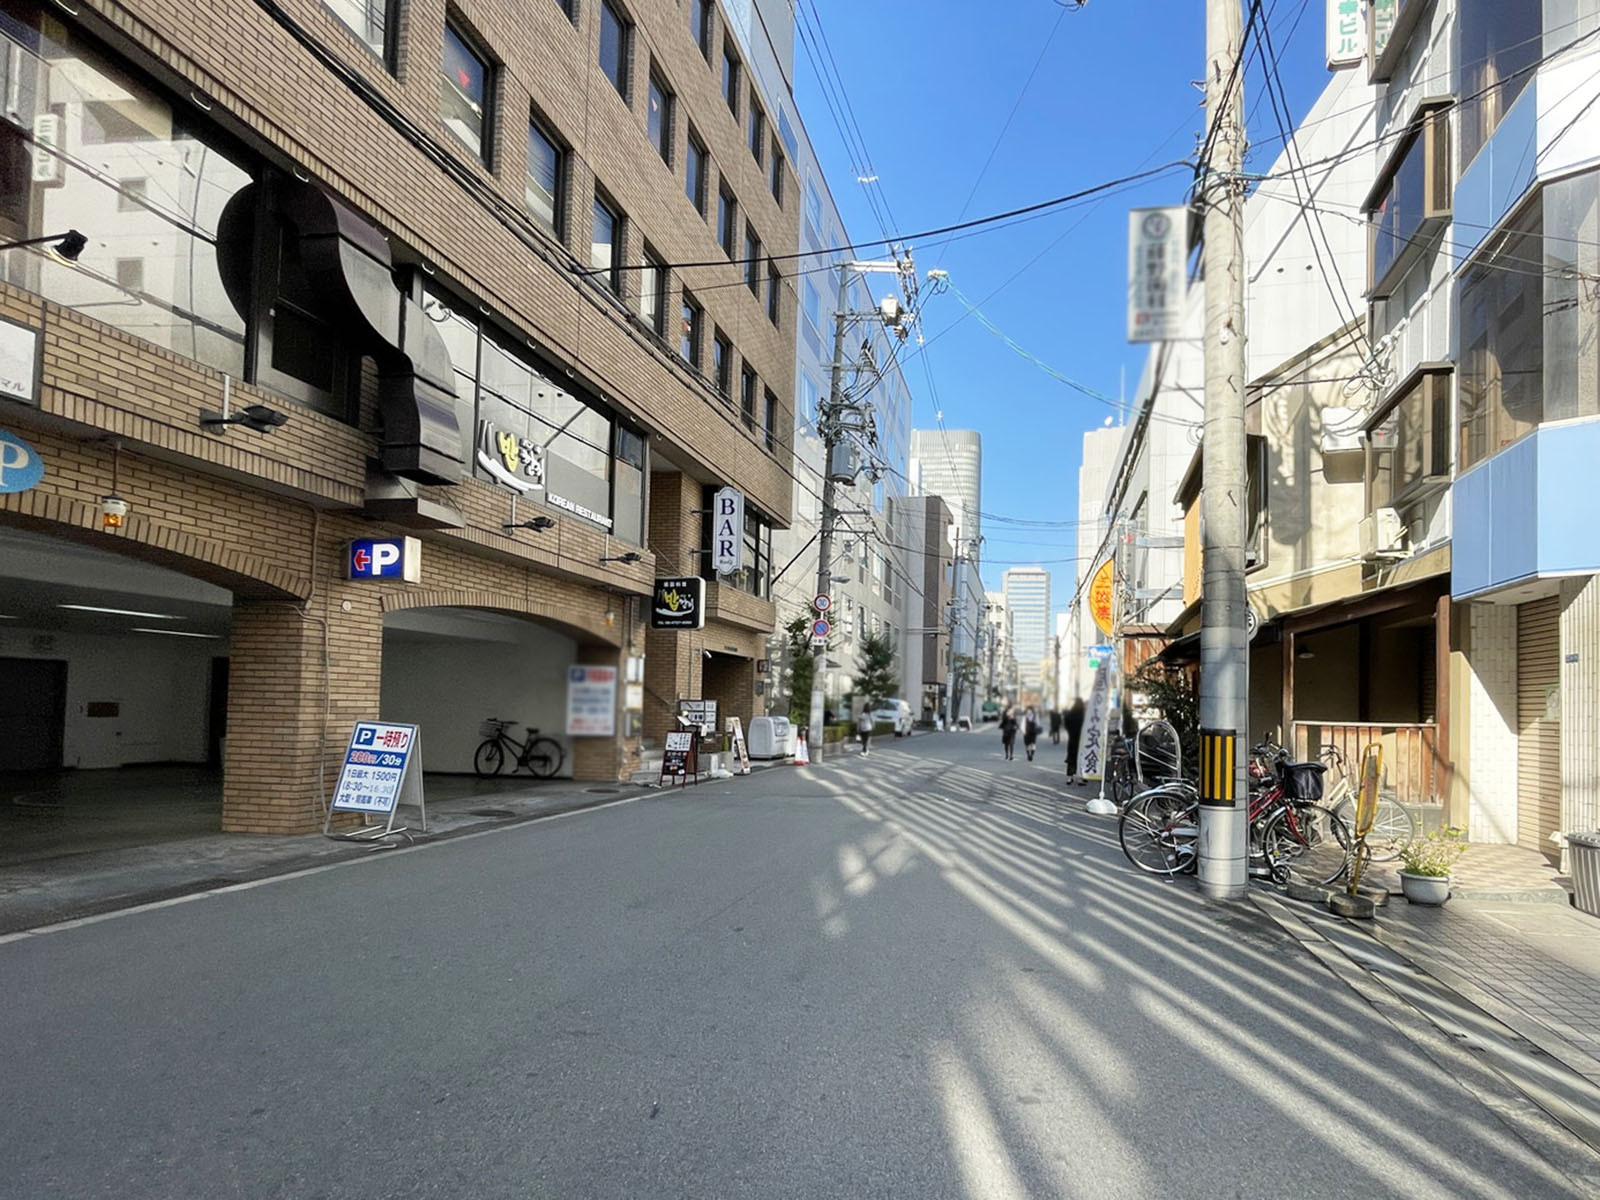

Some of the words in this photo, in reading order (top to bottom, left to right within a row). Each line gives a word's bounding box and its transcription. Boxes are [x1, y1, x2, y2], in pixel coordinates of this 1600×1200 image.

[0, 439, 30, 488] P
[548, 492, 576, 512] KOREAN
[718, 498, 736, 557] BAR
[371, 543, 400, 575] P
[360, 731, 372, 743] P
[376, 730, 408, 748] 一時預り
[371, 771, 398, 783] 1500円
